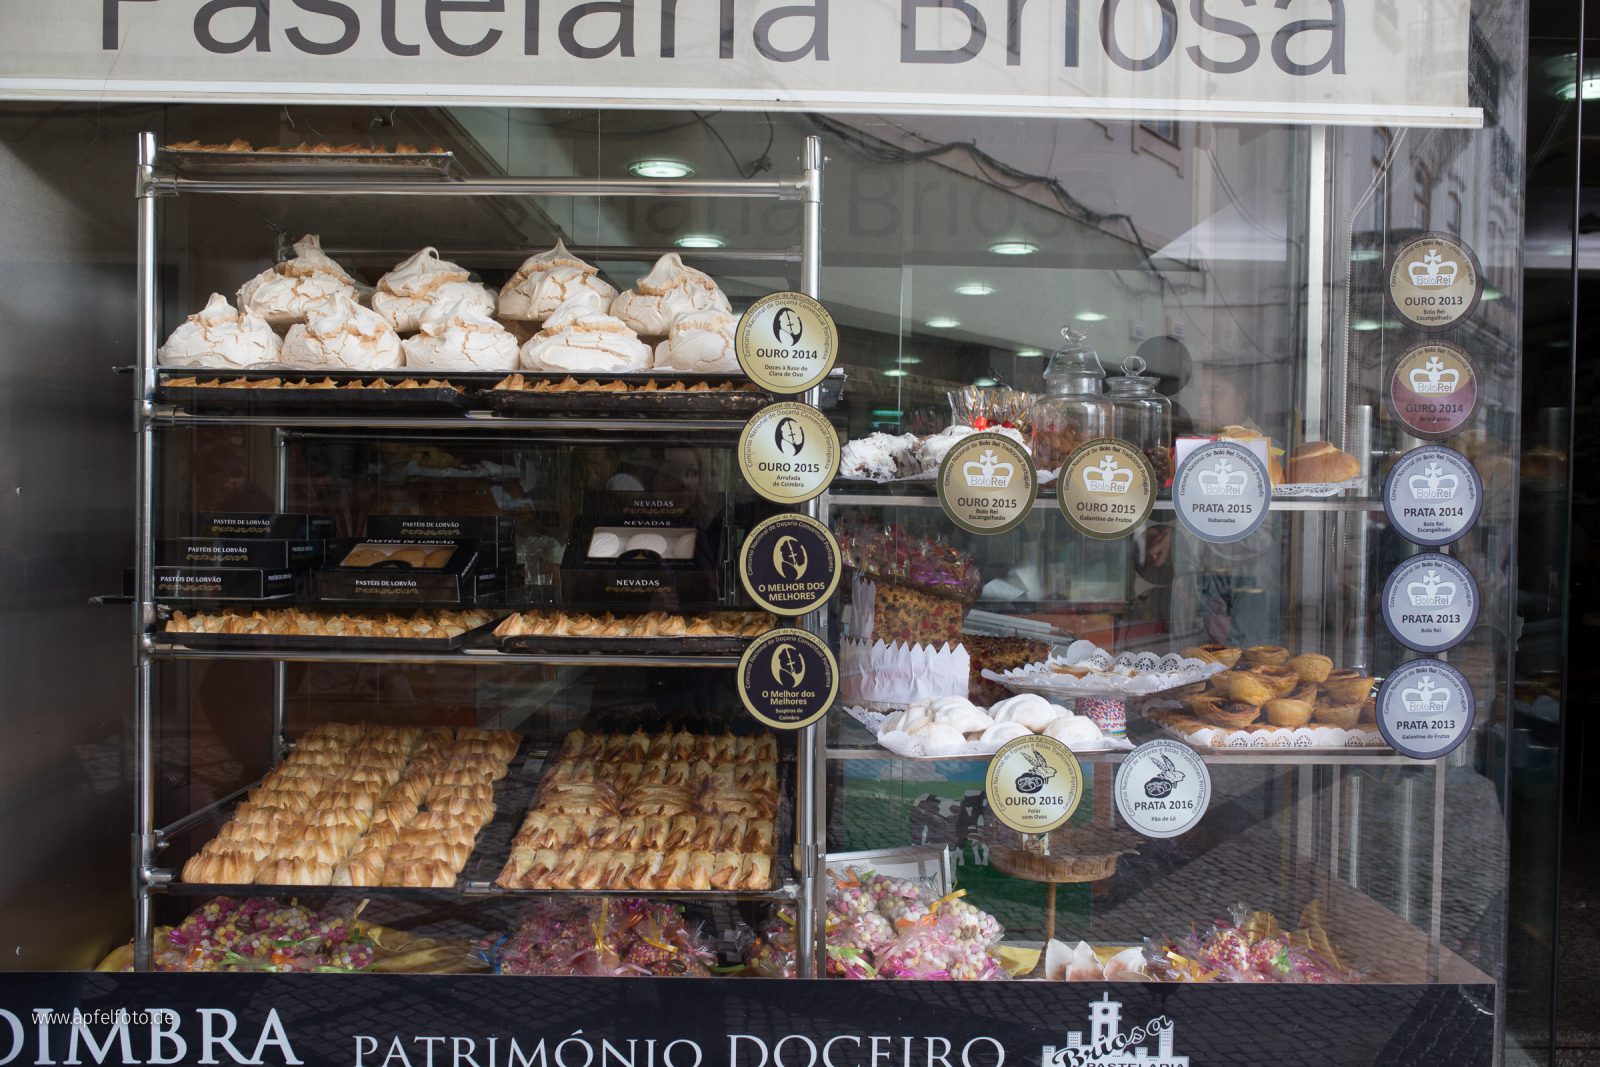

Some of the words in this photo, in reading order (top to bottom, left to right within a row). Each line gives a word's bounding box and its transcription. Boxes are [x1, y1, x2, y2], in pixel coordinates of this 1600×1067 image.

[1404, 297, 1435, 306] OURO
[1438, 296, 1463, 306] 2013
[756, 348, 789, 359] OURO
[792, 349, 818, 360] 2014
[1405, 403, 1437, 413] OURO
[1439, 403, 1464, 413] 2014
[758, 462, 791, 472] OURO
[794, 463, 820, 473] 2015
[957, 497, 989, 507] OURO
[991, 498, 1017, 509] 2015
[1076, 502, 1108, 513] OURO
[1110, 503, 1136, 514] 2015
[1192, 503, 1225, 513] PRATA
[1227, 504, 1252, 514] 2015
[1403, 507, 1436, 517] PRATA
[1438, 507, 1464, 517] 2014
[616, 579, 660, 587] NEVADAS
[758, 584, 766, 593] O
[767, 583, 805, 592] MELHOR
[806, 582, 825, 591] DOS
[768, 592, 816, 601] MELHORES
[1401, 614, 1434, 624] PRATA
[1436, 614, 1461, 624] 2013
[761, 690, 769, 698] O
[770, 690, 800, 698] Melhor
[800, 690, 816, 698] dos
[770, 698, 808, 706] Melhores
[1396, 720, 1429, 730] PRATA
[1431, 720, 1456, 729] 2013
[1005, 796, 1036, 806] OURO
[1039, 796, 1064, 805] 2016
[1134, 801, 1167, 811] PRATA
[1169, 800, 1194, 810] 2016
[352, 1029, 702, 1067] PATRIMÓNIO
[726, 1033, 1006, 1067] DOCEIRO
